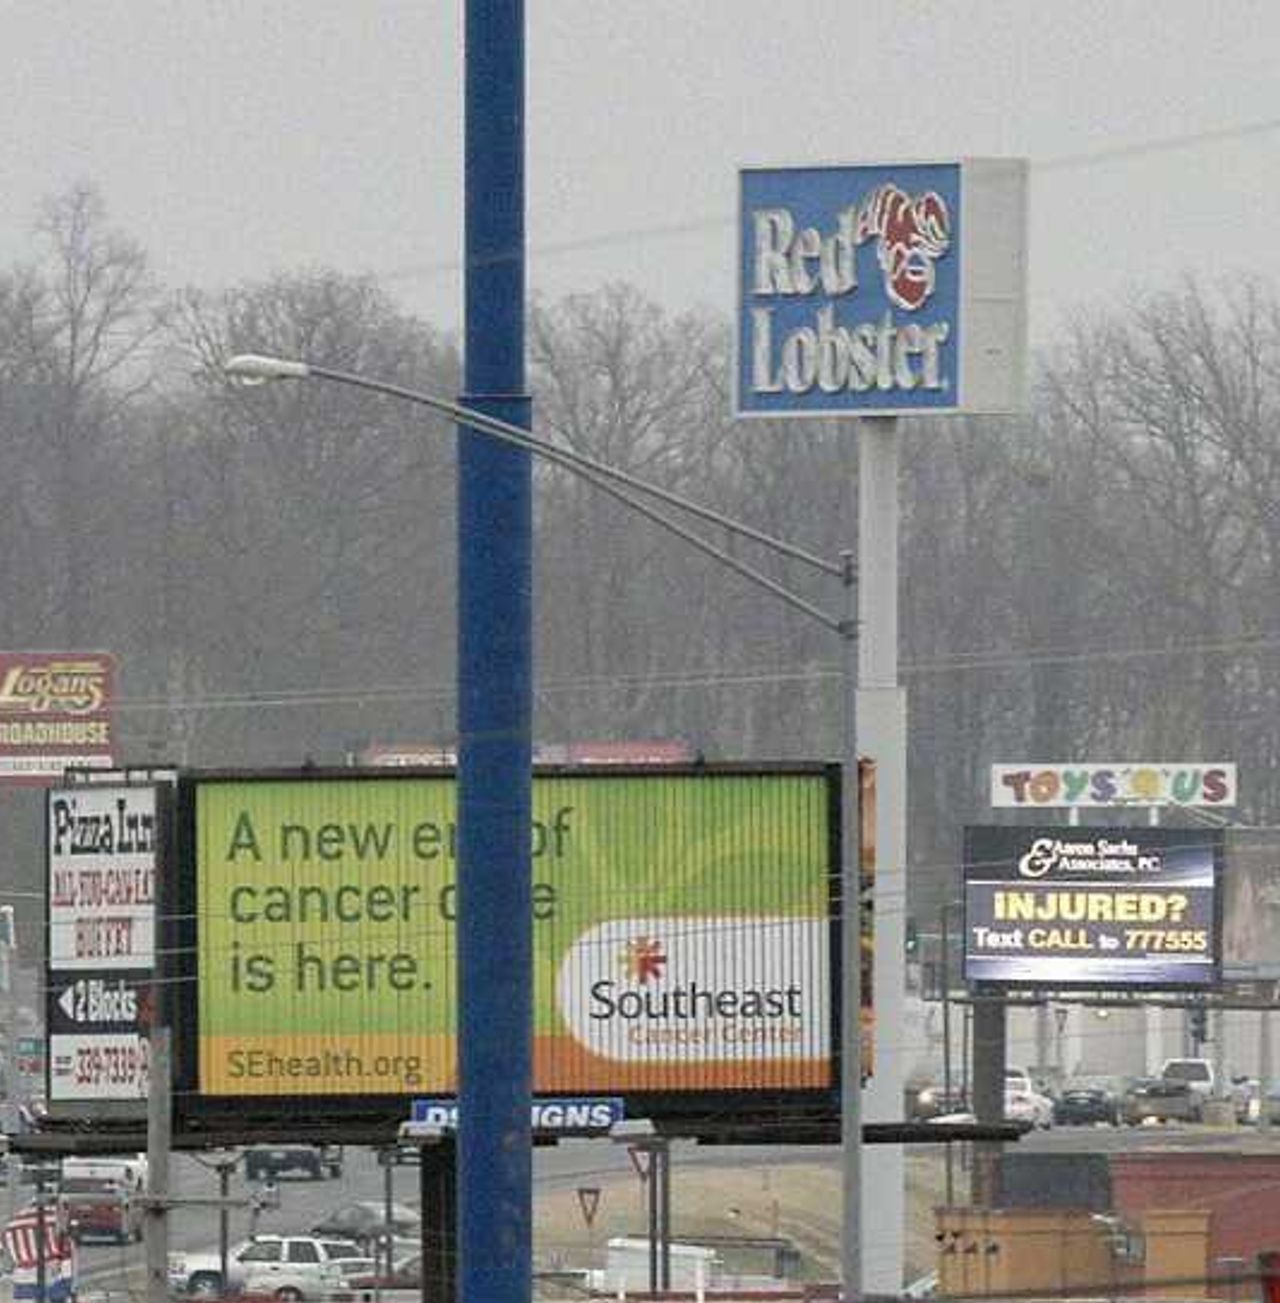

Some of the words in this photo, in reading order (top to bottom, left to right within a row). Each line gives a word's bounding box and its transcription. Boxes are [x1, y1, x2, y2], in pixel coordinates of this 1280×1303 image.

[752, 206, 859, 296] Red
[752, 306, 951, 395] Lobster
[53, 798, 114, 856] Pizza
[116, 798, 154, 853] Inn
[226, 811, 262, 861] A
[280, 822, 392, 861] new
[230, 880, 419, 924] cancer
[438, 882, 556, 922] ce
[993, 892, 1188, 922] INJURED?
[972, 927, 1023, 948] Text
[1027, 929, 1092, 949] CALL
[1098, 932, 1120, 949] to
[1125, 929, 1208, 951] 777555
[229, 943, 275, 993] is
[295, 943, 433, 992] here.
[74, 979, 86, 1022] 2
[88, 979, 138, 1022] Blocks
[589, 980, 802, 1020] Southeast
[227, 1049, 422, 1083] SEhealth.org
[530, 1105, 612, 1128] IGNS
